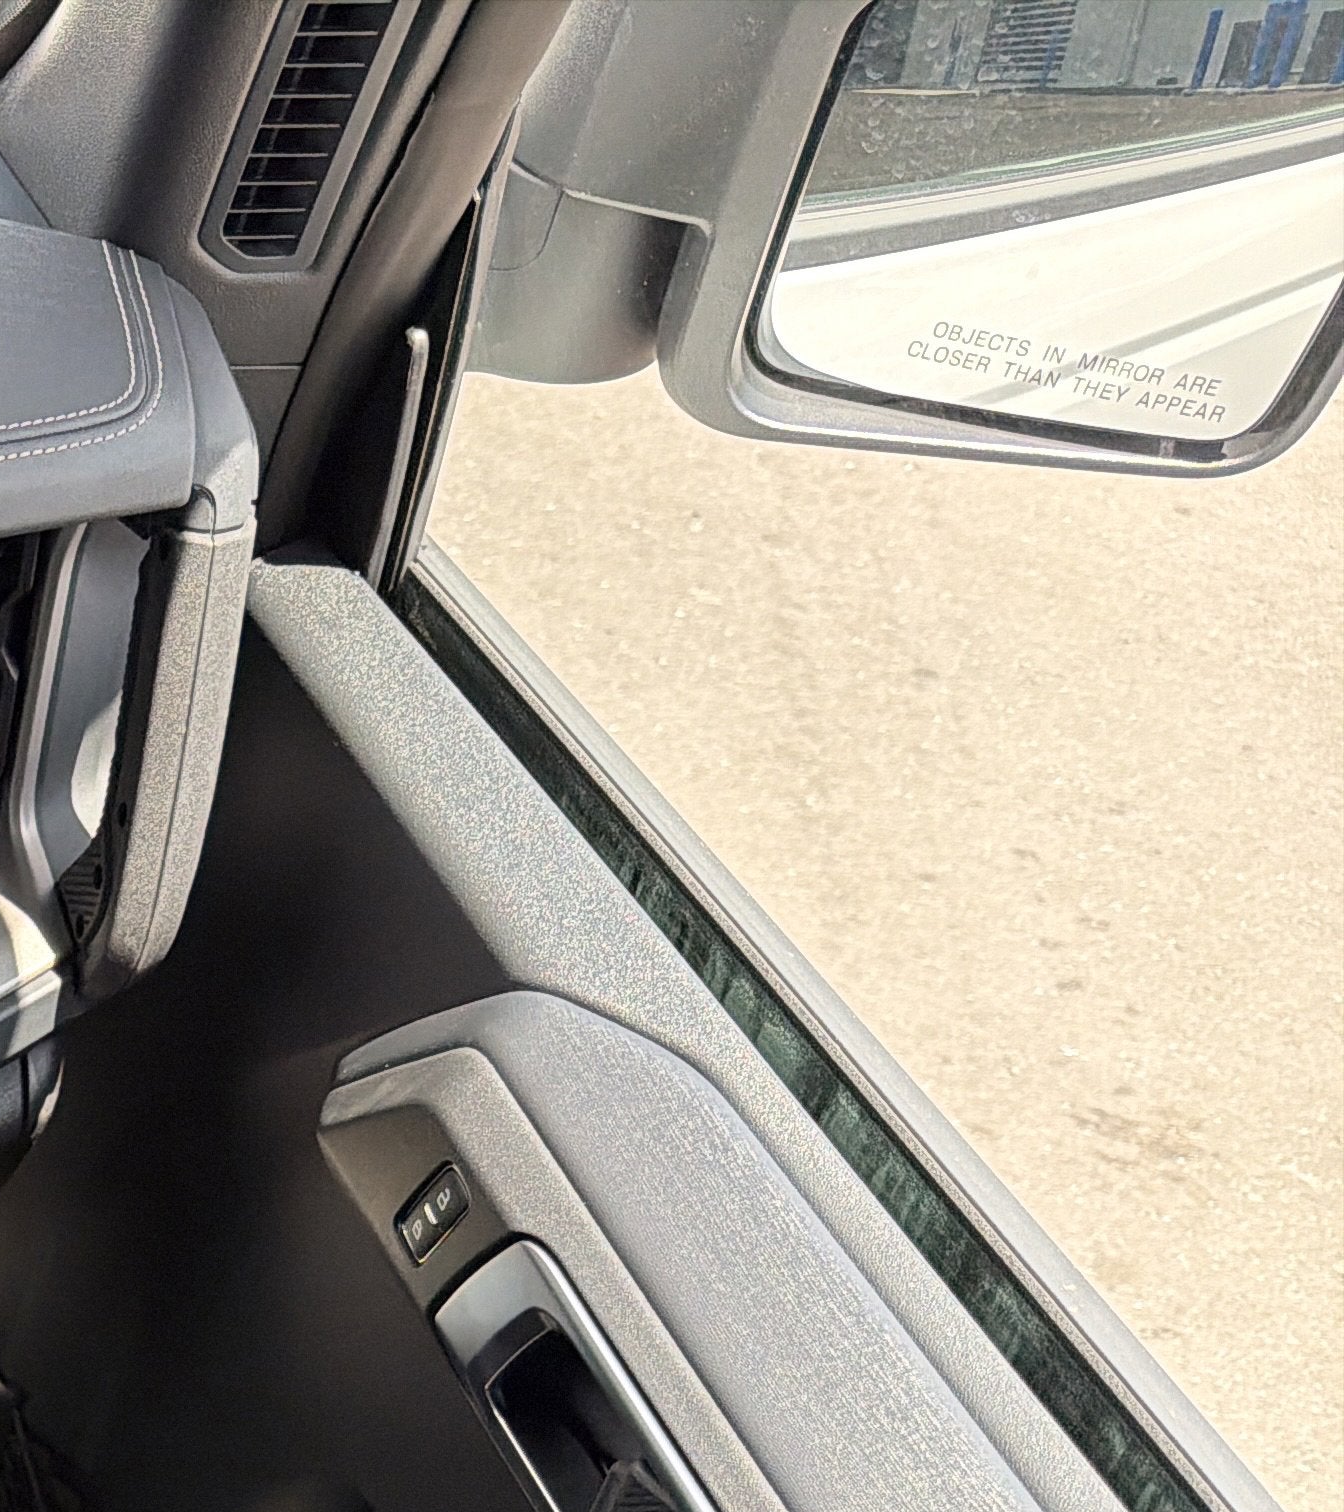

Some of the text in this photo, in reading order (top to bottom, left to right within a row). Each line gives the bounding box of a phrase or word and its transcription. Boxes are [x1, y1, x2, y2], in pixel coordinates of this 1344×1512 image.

[907, 340, 1226, 424] CLOSER THAN THEY APPEAR
[932, 320, 1222, 397] OBJECTS IN MIRROR ARE
